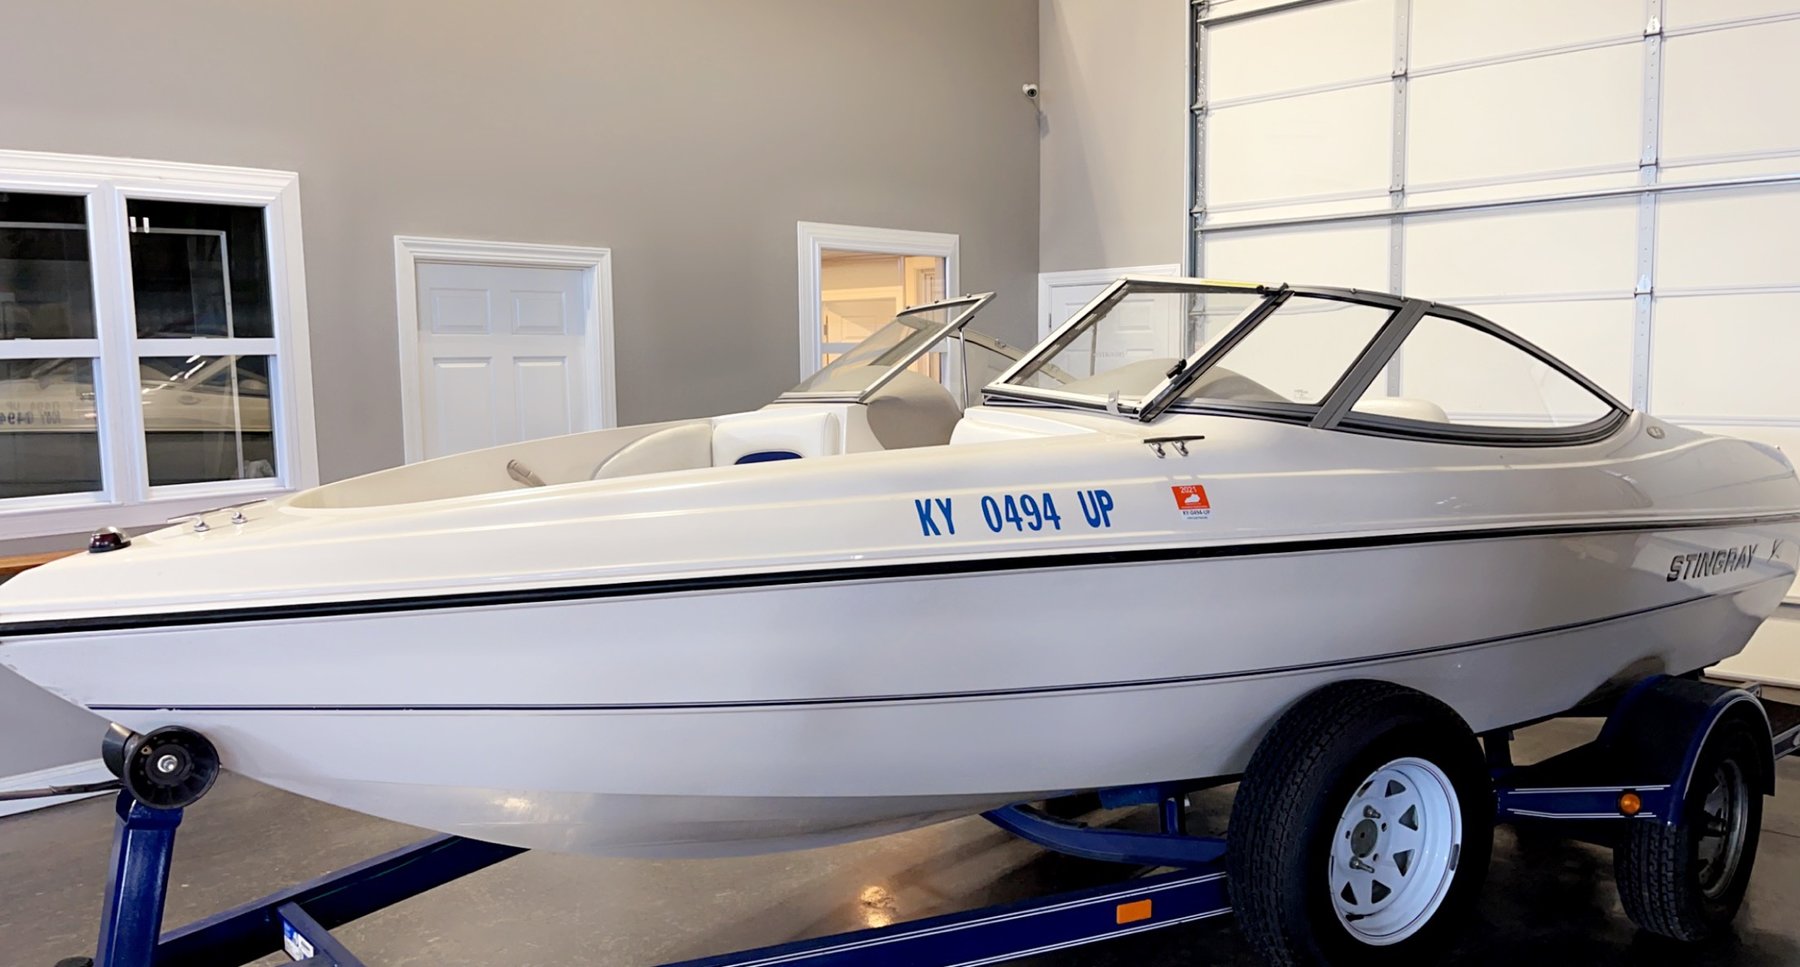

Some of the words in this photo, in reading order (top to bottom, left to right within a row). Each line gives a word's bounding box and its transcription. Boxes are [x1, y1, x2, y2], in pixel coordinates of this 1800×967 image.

[914, 498, 955, 536] KY
[981, 492, 1061, 533] 0494
[1077, 489, 1114, 528] UP
[1666, 543, 1758, 582] STINGRAY
